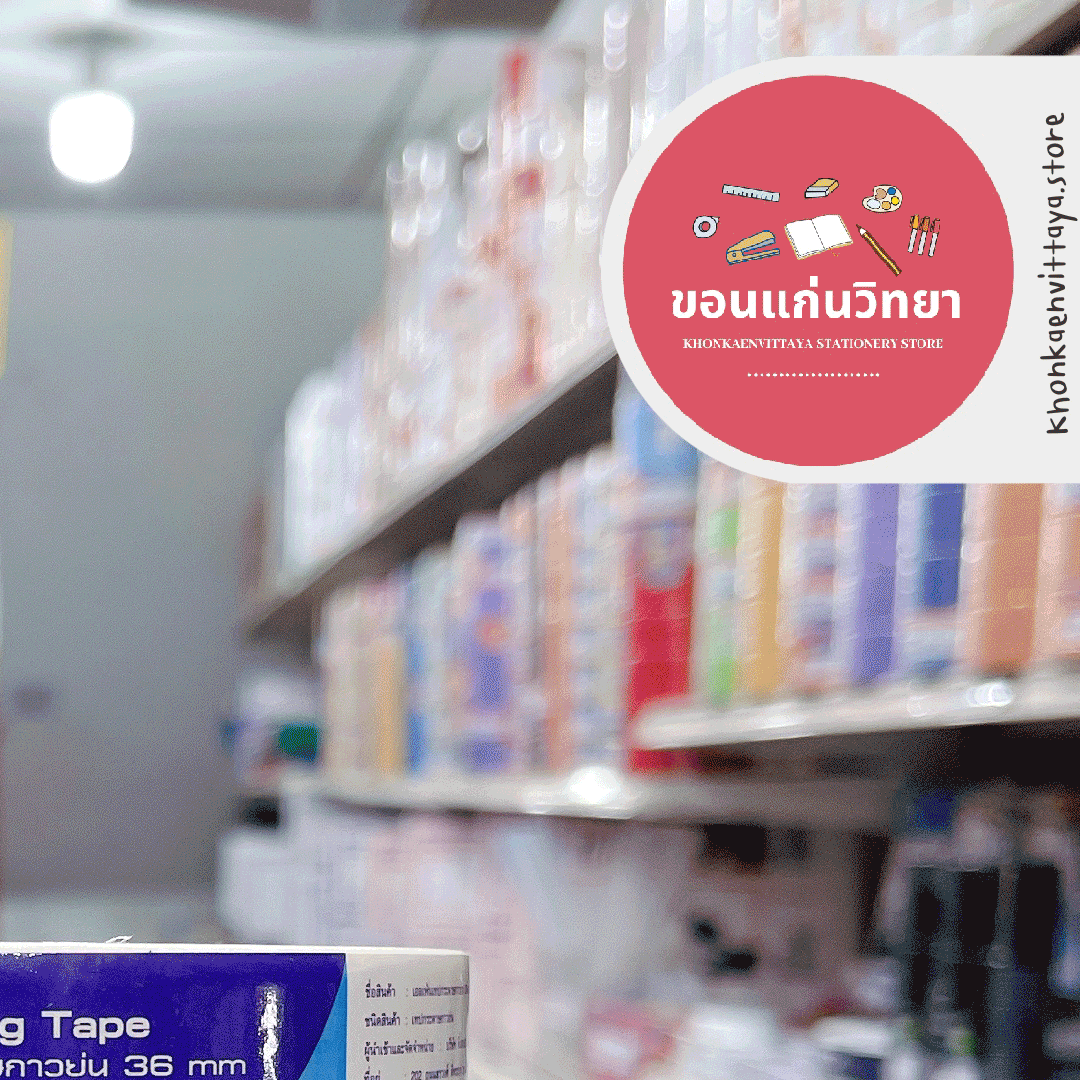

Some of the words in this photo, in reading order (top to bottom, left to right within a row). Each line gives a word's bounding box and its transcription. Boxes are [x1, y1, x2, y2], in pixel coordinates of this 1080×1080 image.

[365, 979, 396, 998] ชื่อสินค้า
[41, 1010, 151, 1045] Tape
[123, 1054, 174, 1078] 36
[187, 1058, 247, 1077] mm
